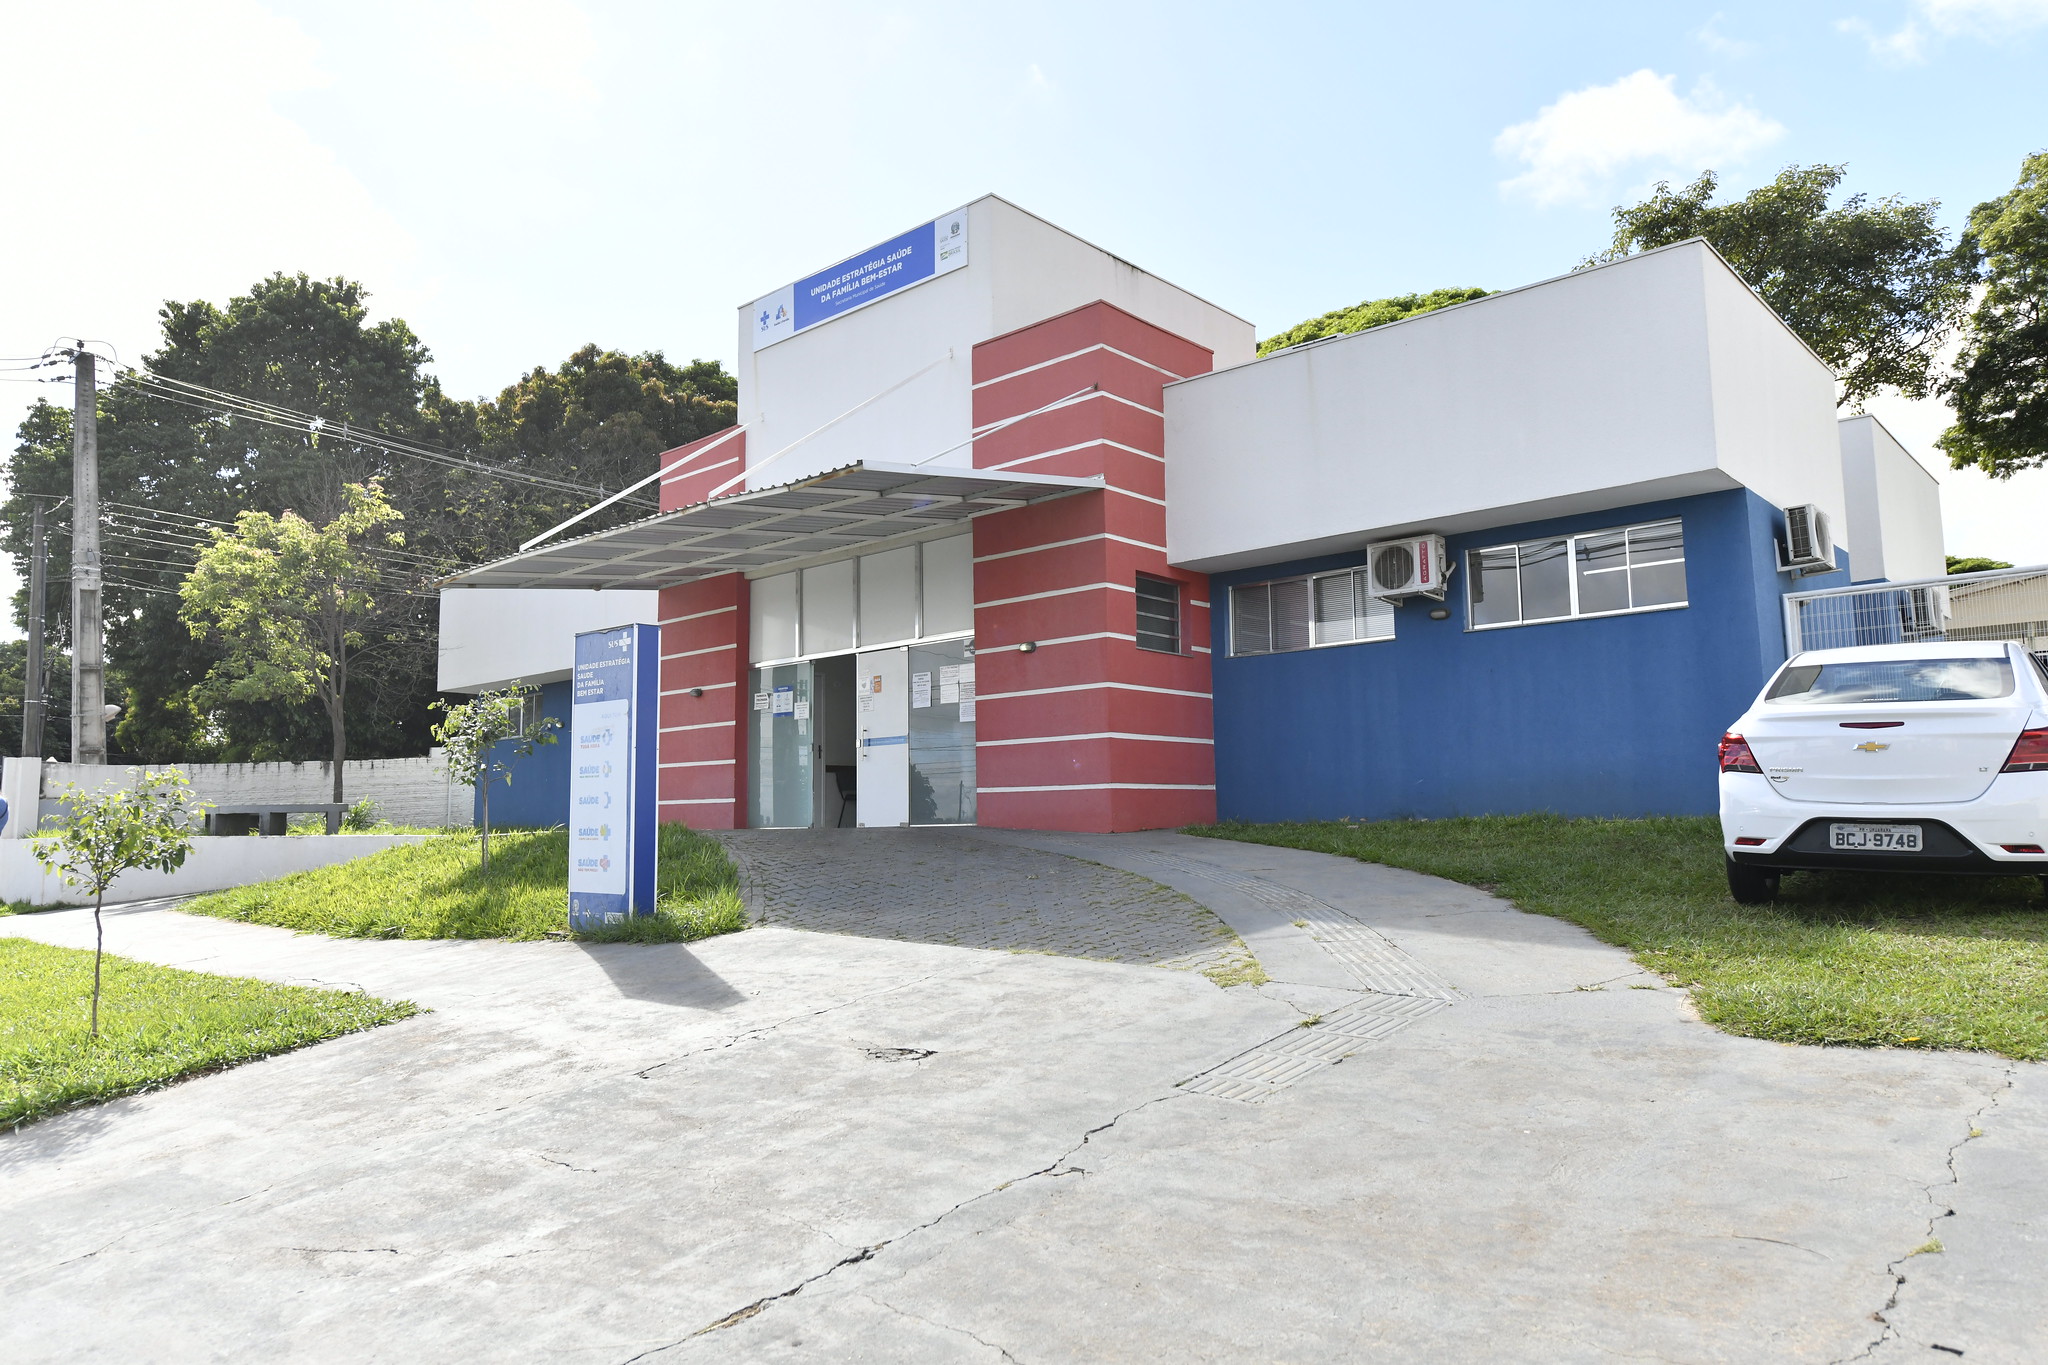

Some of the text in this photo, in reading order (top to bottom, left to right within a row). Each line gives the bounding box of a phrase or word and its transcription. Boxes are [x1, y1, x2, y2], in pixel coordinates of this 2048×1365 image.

[810, 246, 912, 297] UNIDADE ESTRATÉGIA SAÚDE
[821, 262, 903, 303] DA FAMÍLIA BEM-ESTAR
[608, 639, 618, 648] SUS
[577, 661, 599, 671] UNIDADE
[577, 687, 604, 697] BEM ESTAR
[578, 826, 599, 836] SAÚDE
